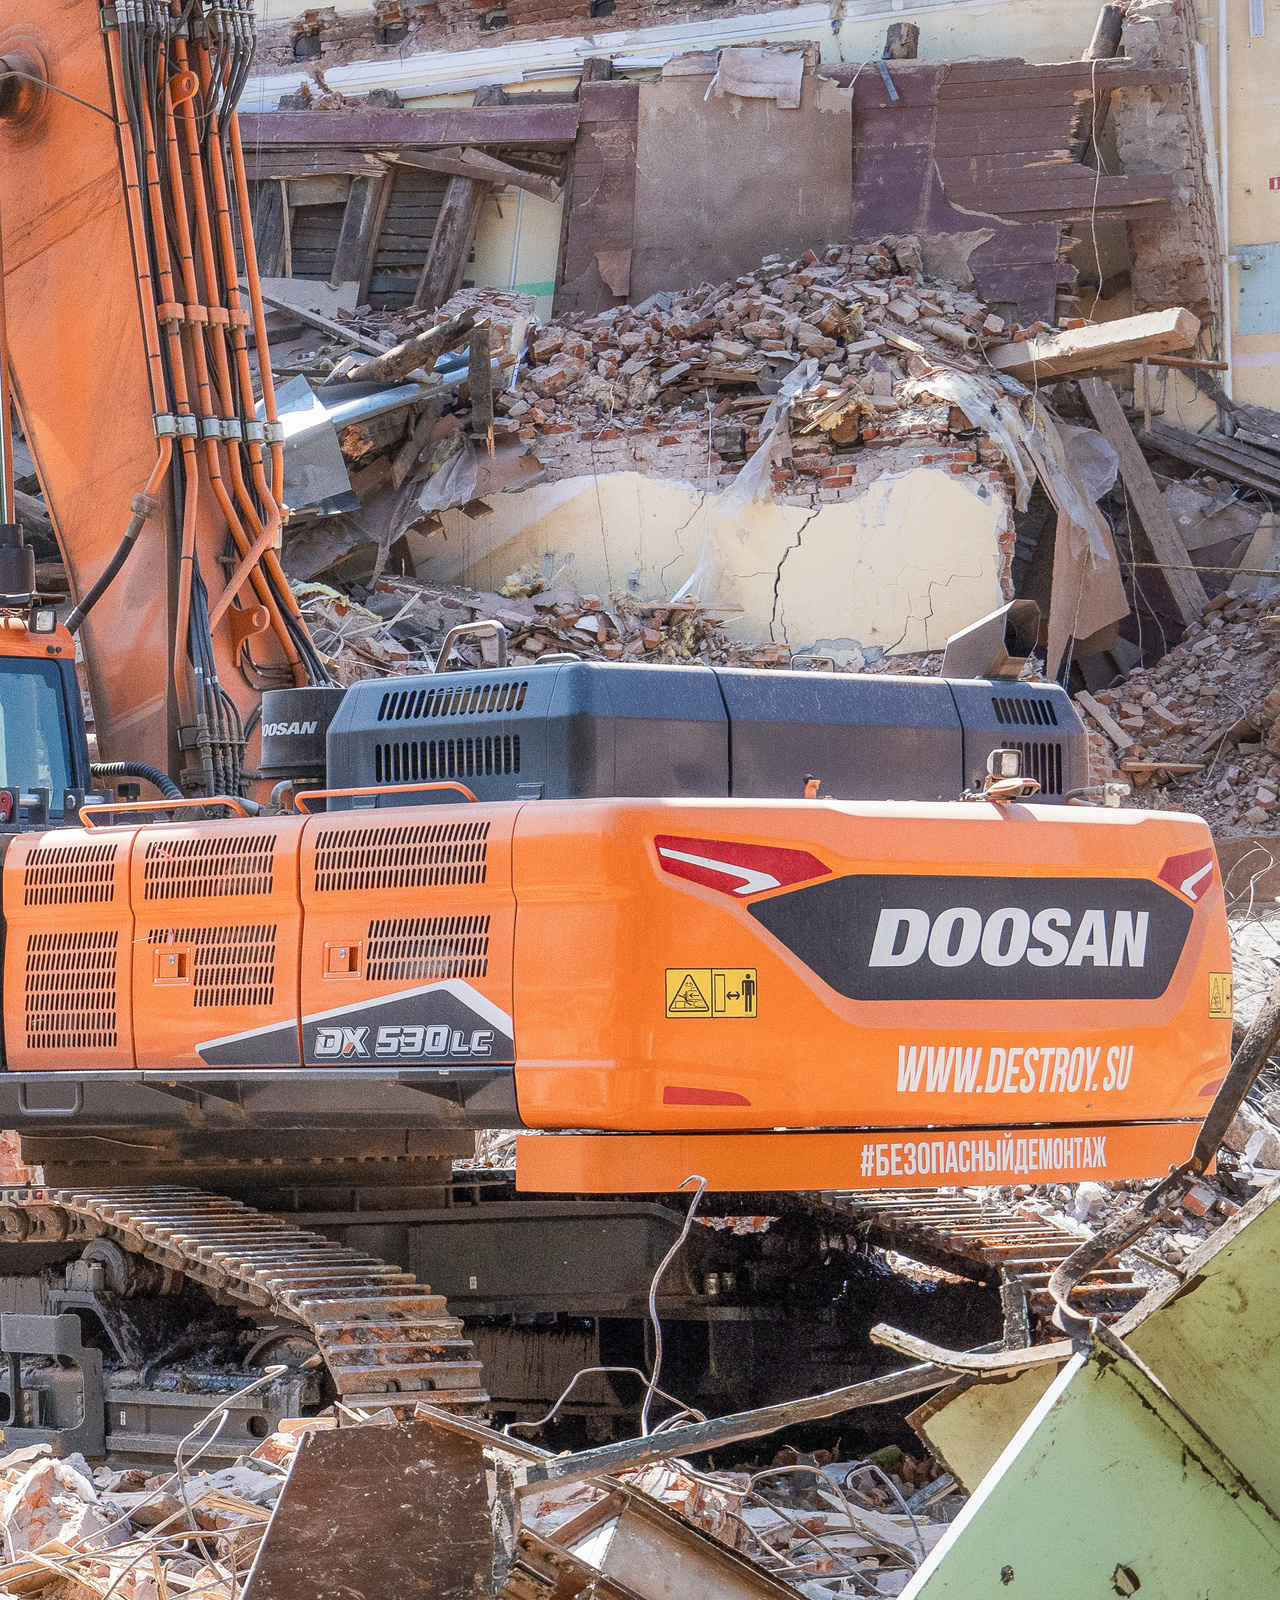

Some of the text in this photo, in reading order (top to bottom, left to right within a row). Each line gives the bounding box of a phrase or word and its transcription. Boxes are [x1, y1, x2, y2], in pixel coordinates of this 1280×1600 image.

[868, 906, 1150, 967] DOOSAN
[314, 1026, 371, 1058] DX
[896, 1045, 1134, 1093] WWW.DESTROY.SU
[860, 1132, 1107, 1177] #БЕЗОПАСНЫЙДЕМОНТАЖ
